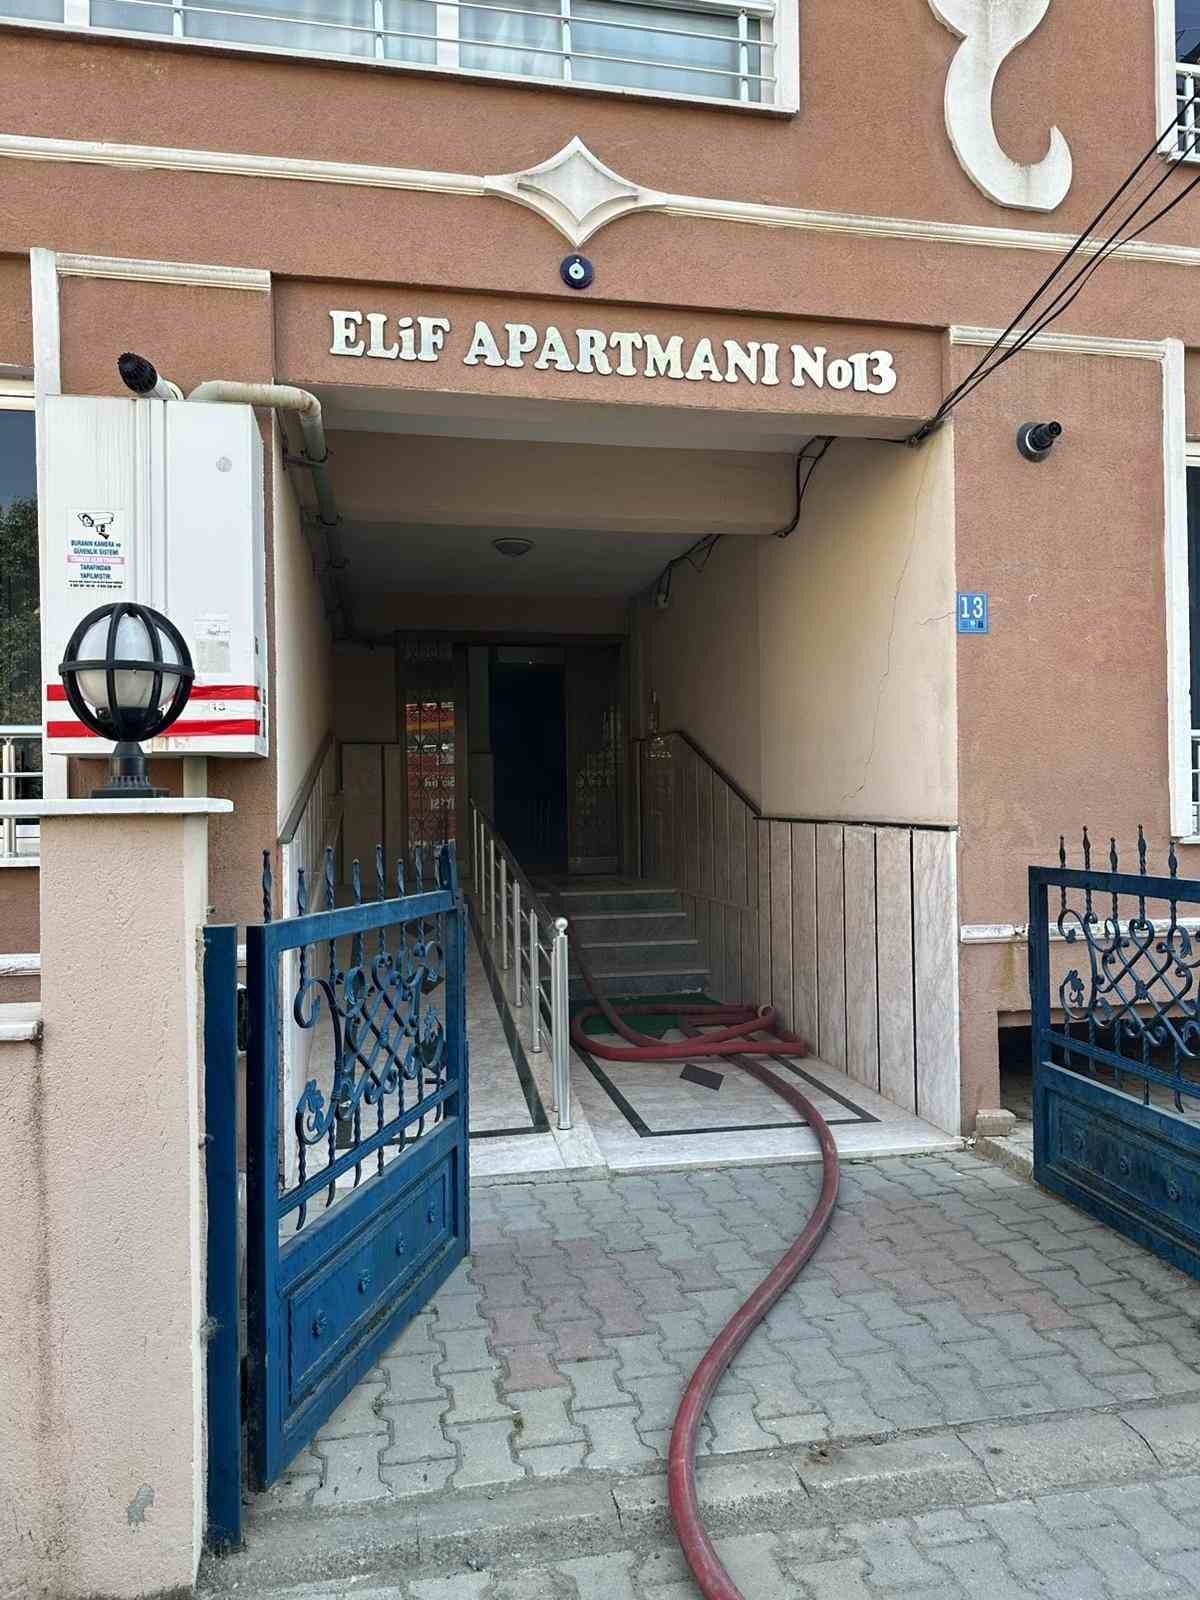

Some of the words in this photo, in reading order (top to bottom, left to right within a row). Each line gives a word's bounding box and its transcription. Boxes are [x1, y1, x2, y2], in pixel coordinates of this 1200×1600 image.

[329, 310, 451, 363] ELiF
[463, 320, 780, 386] APARTMANI
[961, 596, 984, 619] 13
